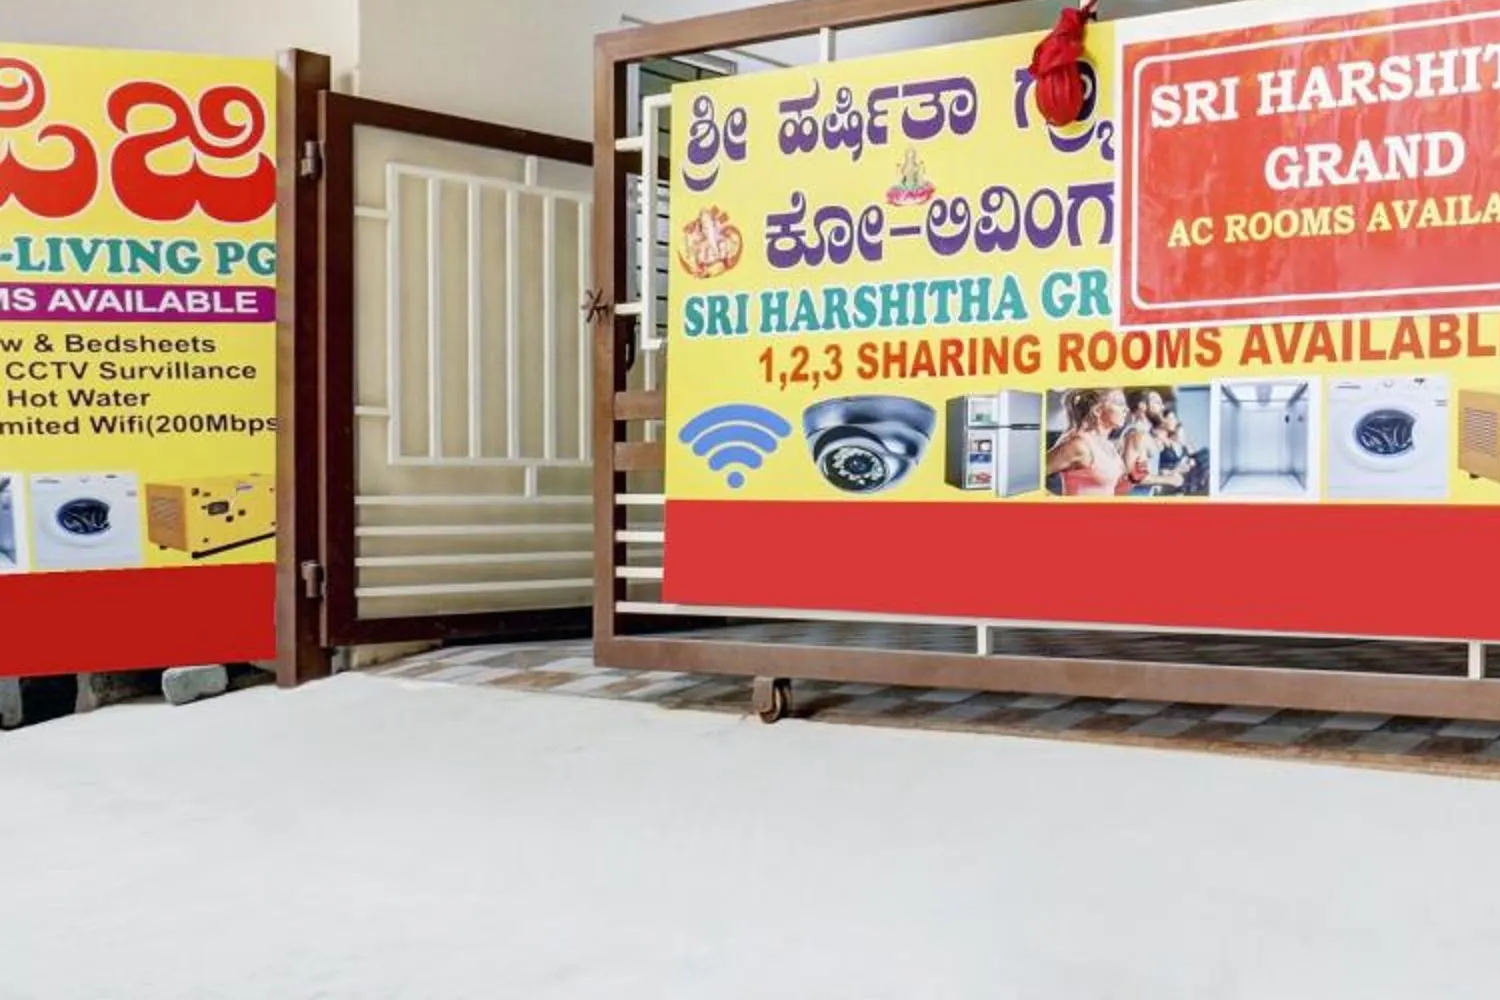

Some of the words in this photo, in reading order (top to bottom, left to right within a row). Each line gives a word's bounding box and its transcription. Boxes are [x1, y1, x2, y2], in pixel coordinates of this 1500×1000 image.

[1151, 76, 1238, 129] SRI
[682, 94, 748, 192] ಶ್ರೀ
[778, 76, 978, 163] ಹರ್ಷಿತಾ
[1264, 130, 1466, 191] GRAND
[1167, 216, 1214, 249] AC
[1223, 203, 1355, 242] ROOMS
[214, 240, 277, 276] PG
[48, 288, 259, 313] AVAILABLE
[684, 293, 750, 338] SRI
[760, 271, 1029, 334] HARSHITHA
[33, 333, 54, 353] &
[65, 333, 217, 353] Bedsheets
[757, 342, 844, 391] 1,2,3
[856, 336, 1041, 380] SHARING
[1057, 325, 1222, 373] ROOMS
[5, 361, 89, 381] CCTV
[99, 362, 257, 381] Survillance
[6, 388, 58, 408] Hot
[67, 388, 151, 408] Water
